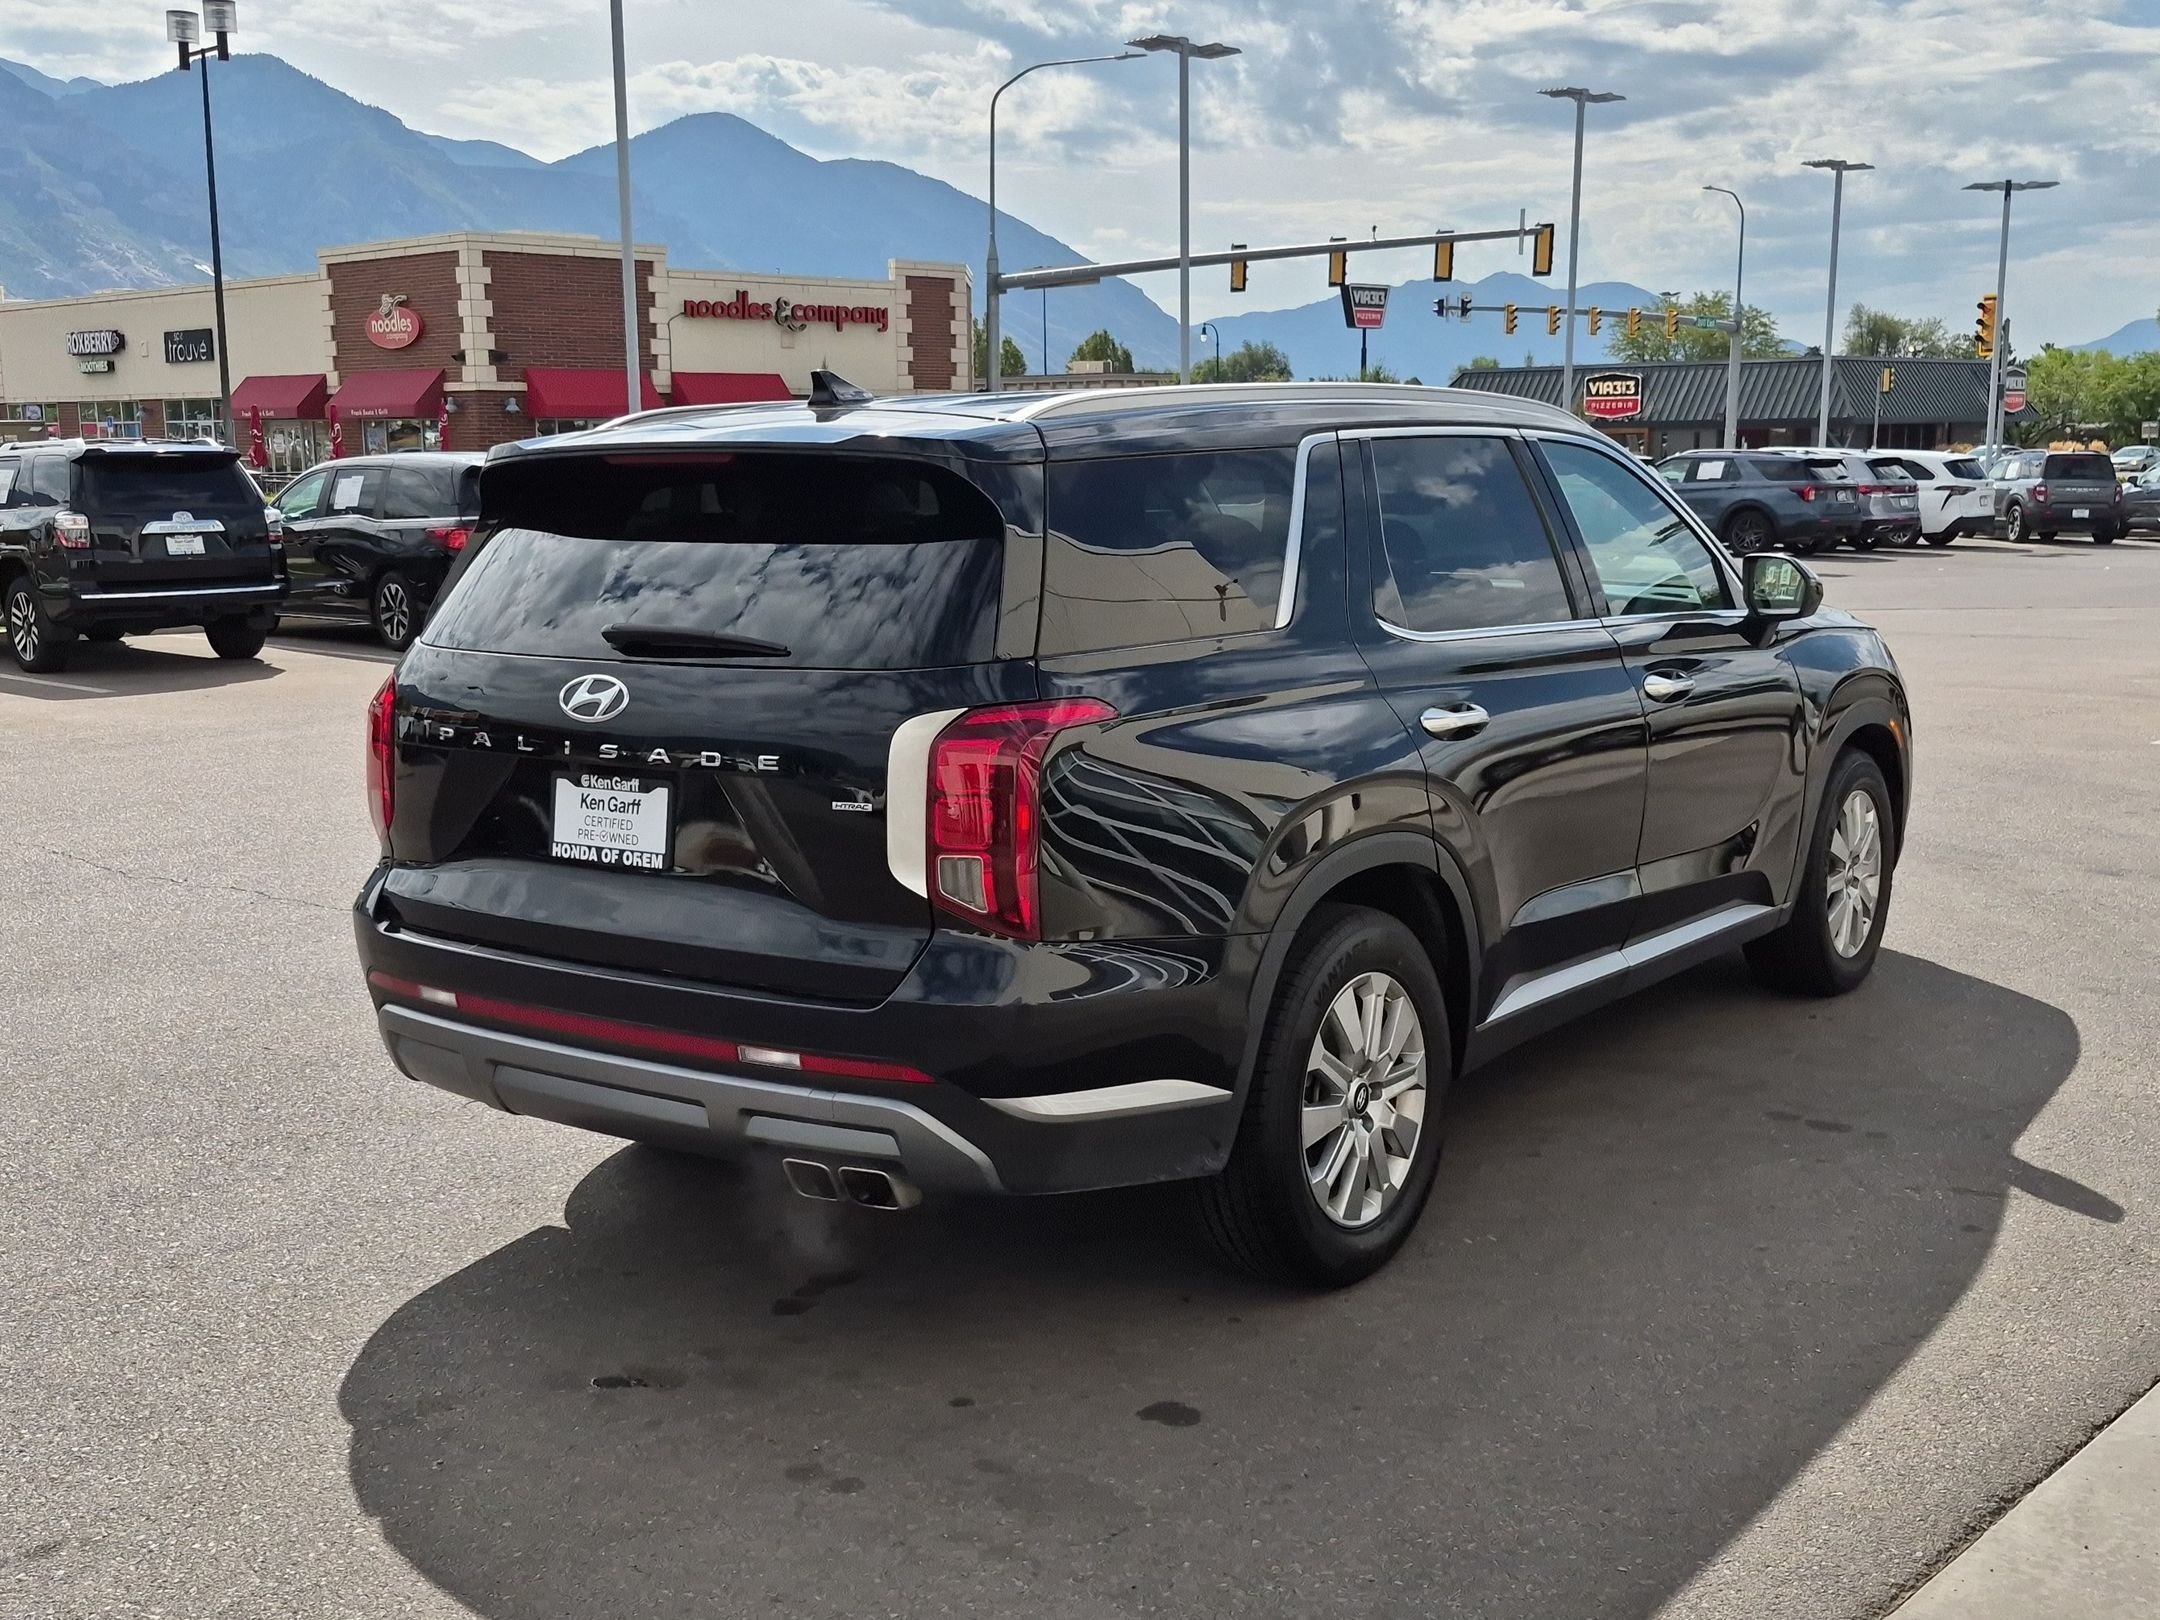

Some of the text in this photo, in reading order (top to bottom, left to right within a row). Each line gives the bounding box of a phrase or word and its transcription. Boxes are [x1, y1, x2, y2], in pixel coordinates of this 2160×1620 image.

[371, 310, 412, 333] noodles
[684, 290, 773, 320] noodles
[792, 303, 889, 332] company
[66, 331, 113, 354] ROXBERRY
[439, 726, 780, 771] PALISADE
[611, 776, 640, 793] Garff
[580, 792, 641, 815] Ken Garff
[584, 814, 634, 831] CERTIFIED
[551, 842, 663, 870] HONDA OF OREM
